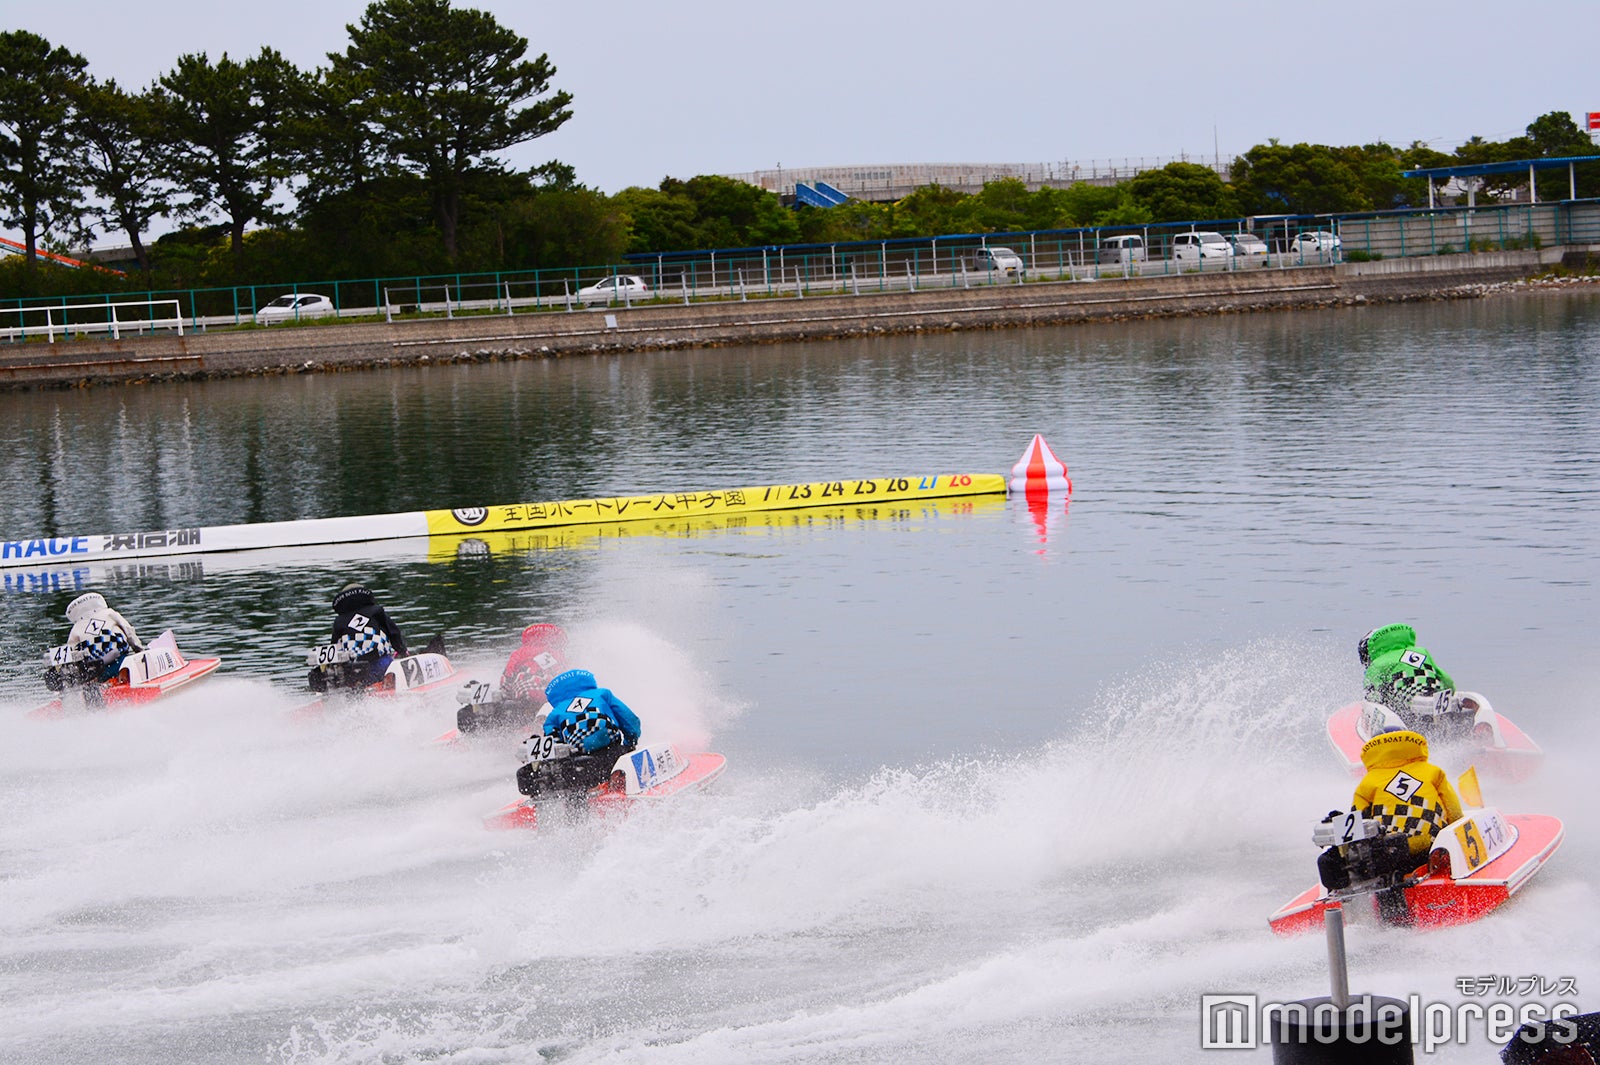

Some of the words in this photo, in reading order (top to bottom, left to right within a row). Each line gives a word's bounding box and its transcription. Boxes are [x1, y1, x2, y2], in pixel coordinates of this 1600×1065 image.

[822, 482, 844, 497] 24
[854, 480, 877, 494] 25
[886, 478, 909, 492] 26
[92, 621, 99, 632] 1
[354, 617, 365, 628] 2
[53, 645, 69, 664] 41
[318, 645, 336, 664] 50
[1409, 652, 1420, 664] 6
[141, 653, 149, 680] 1
[407, 658, 420, 687] 2
[473, 683, 490, 703] 47
[1435, 689, 1451, 714] 45
[531, 737, 553, 760] 49
[1383, 736, 1403, 744] BOAT
[1396, 777, 1412, 796] 5
[1341, 813, 1355, 843] 2
[1463, 821, 1480, 868] 5
